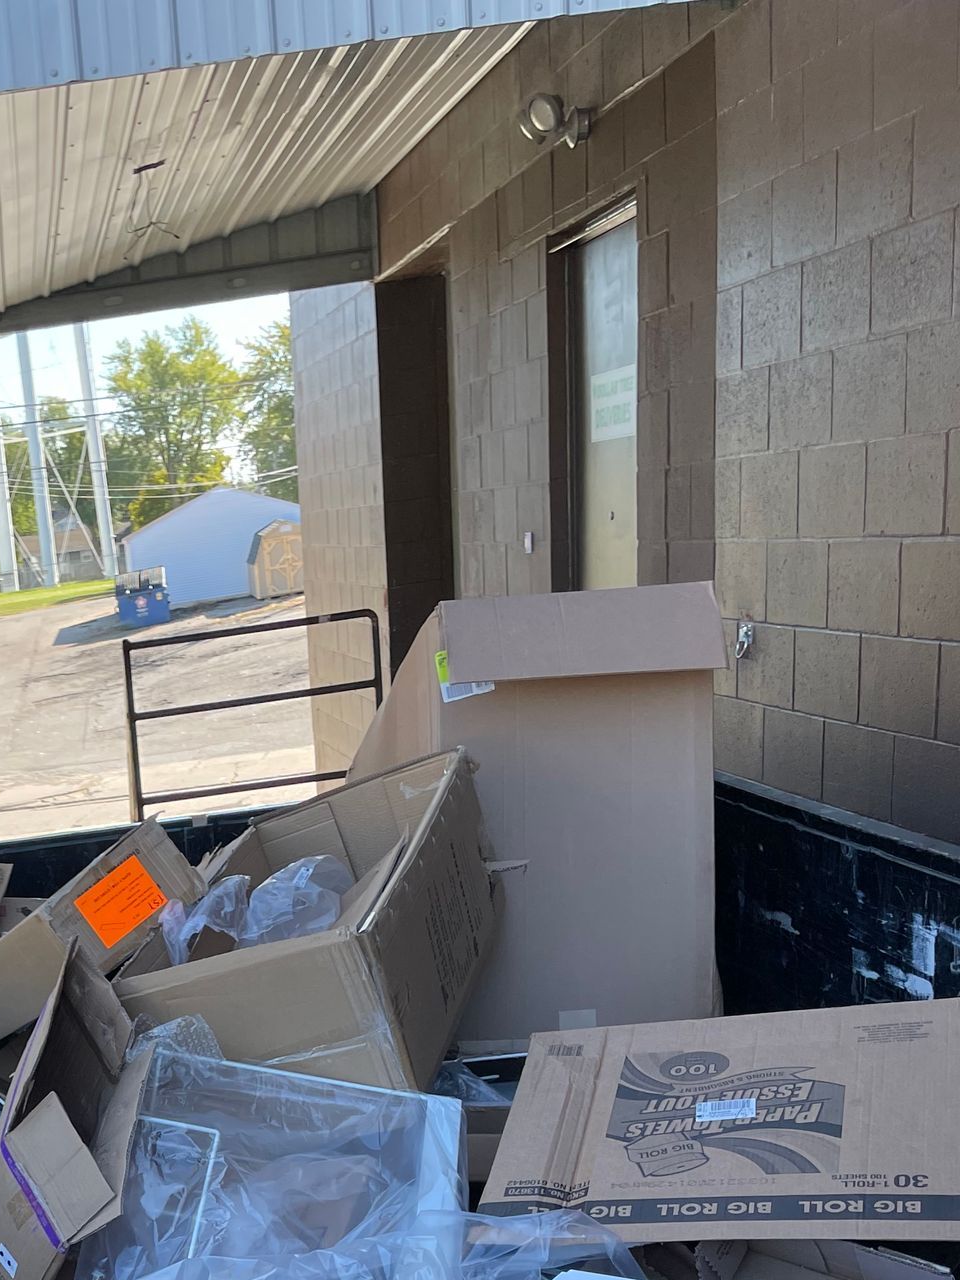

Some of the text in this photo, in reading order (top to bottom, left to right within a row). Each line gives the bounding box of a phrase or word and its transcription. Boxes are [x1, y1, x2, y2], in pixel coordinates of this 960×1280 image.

[669, 1064, 717, 1076] 100
[637, 1144, 694, 1159] BIG ROLL
[843, 1174, 929, 1189] 30 1-ROLL
[591, 1204, 632, 1217] BIG
[657, 1201, 772, 1216] BIG ROLL
[798, 1200, 922, 1213] BIG ROLL
